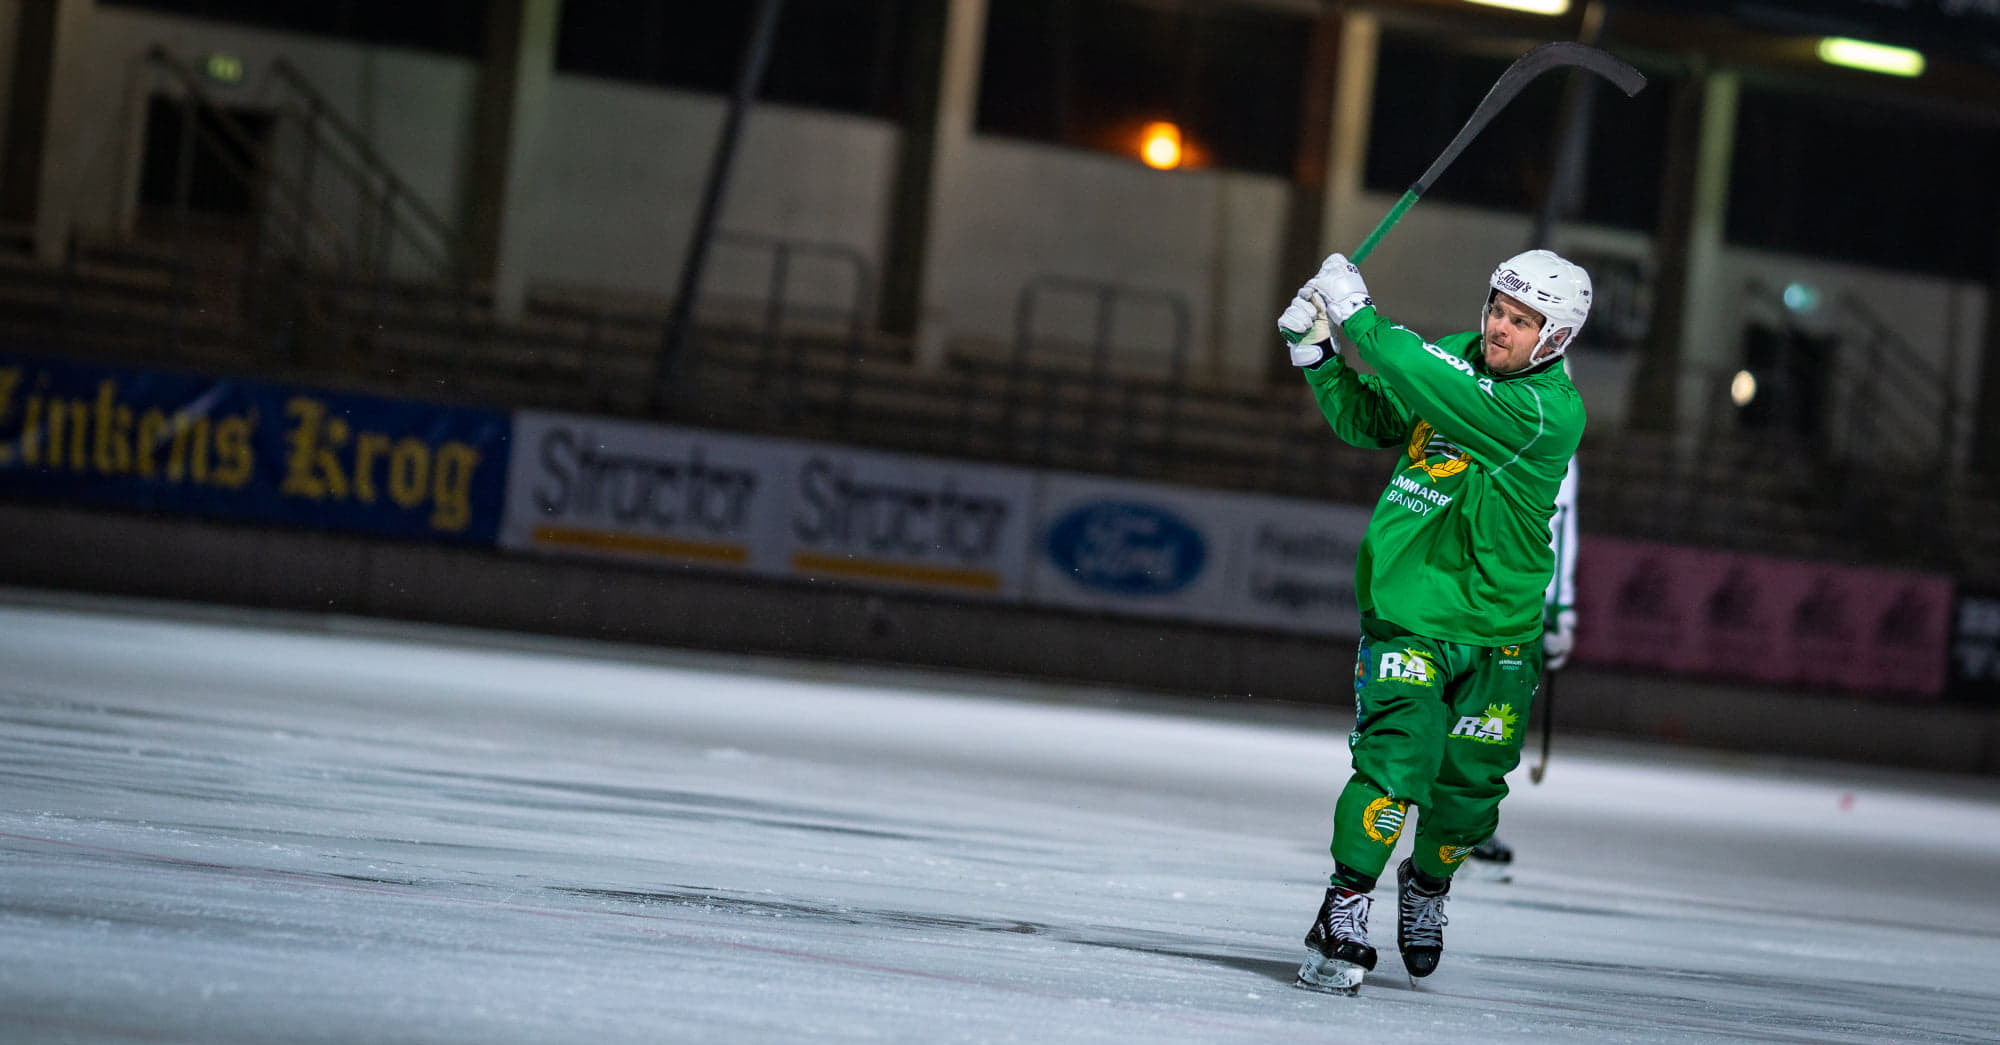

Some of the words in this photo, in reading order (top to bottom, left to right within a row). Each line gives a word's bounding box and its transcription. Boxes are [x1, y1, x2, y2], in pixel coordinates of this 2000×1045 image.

[1498, 269, 1532, 294] Tony's
[280, 396, 482, 531] Krog
[532, 427, 758, 533] Structor
[793, 455, 1011, 560] Structor
[1386, 489, 1433, 517] BANDY
[1379, 651, 1428, 682] RA
[1451, 715, 1503, 741] RA
